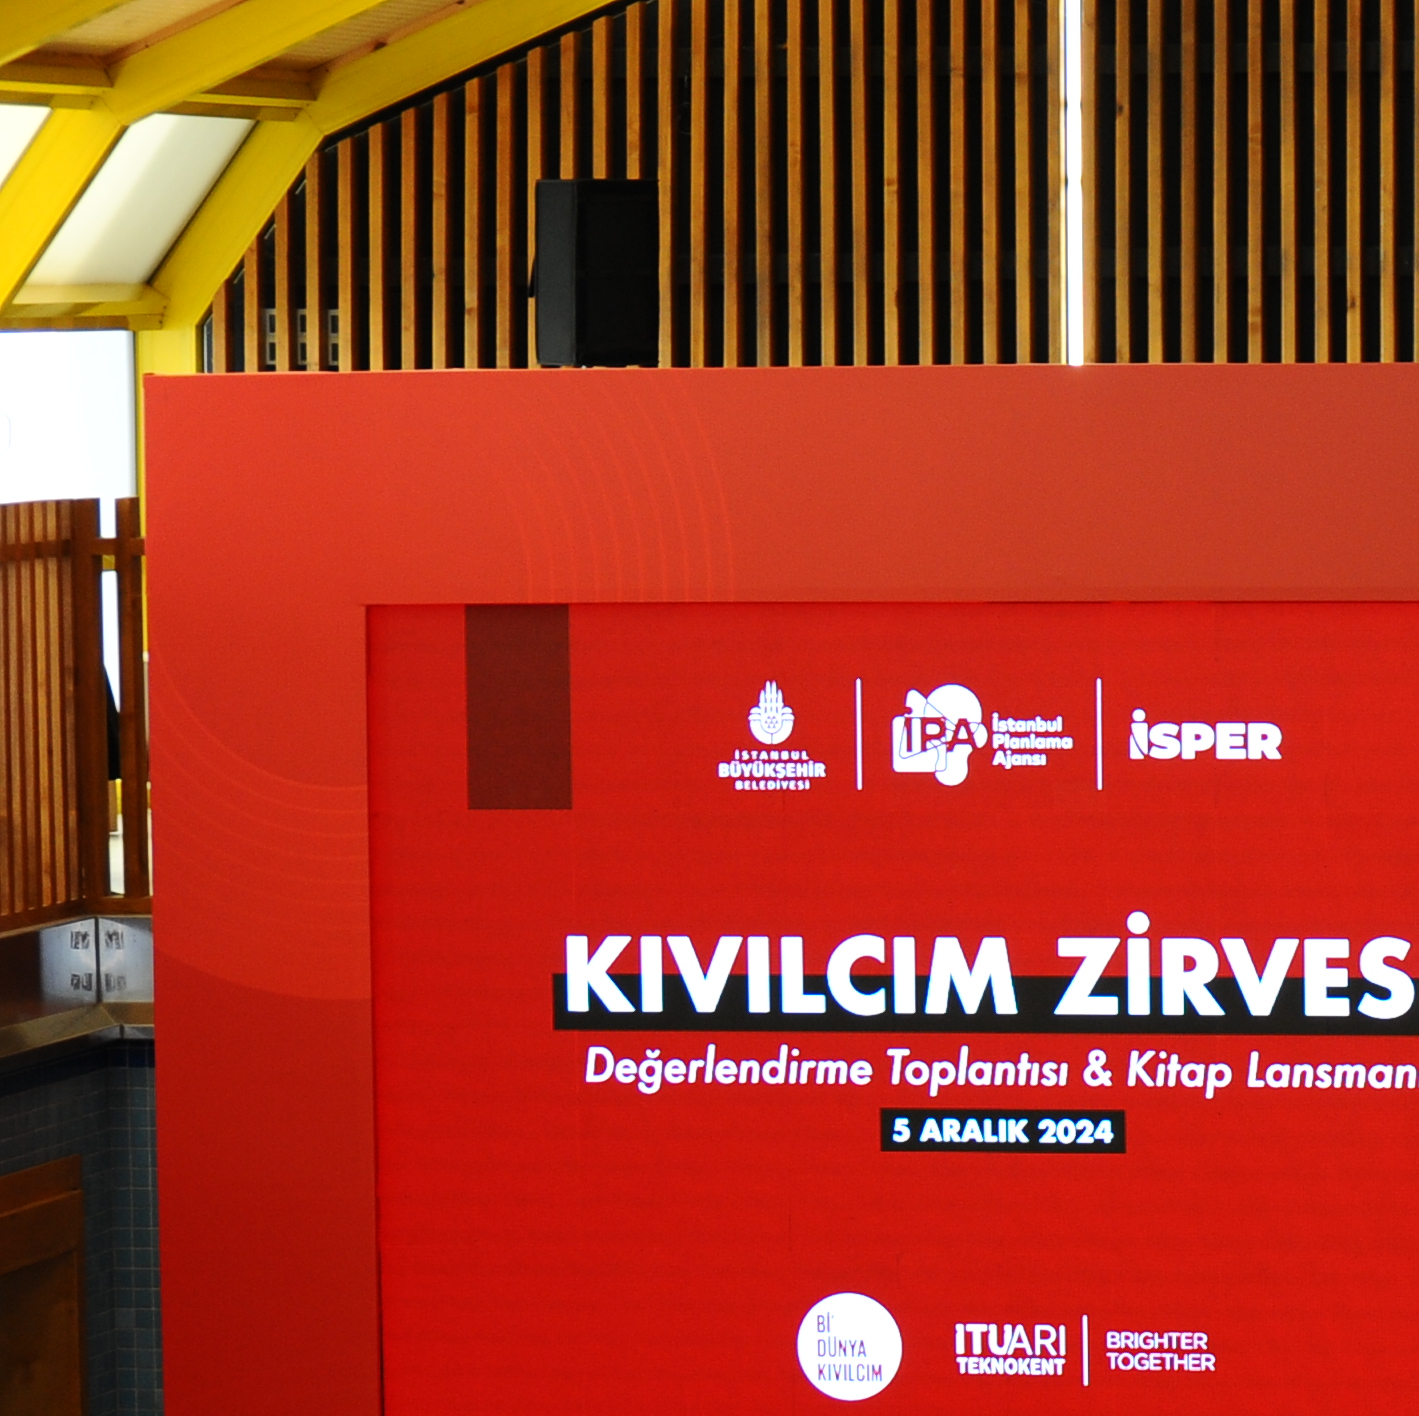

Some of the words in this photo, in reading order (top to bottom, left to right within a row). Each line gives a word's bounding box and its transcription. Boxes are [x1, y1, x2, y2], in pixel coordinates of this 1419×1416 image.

[992, 712, 1062, 733] İstanbul
[993, 733, 1073, 749] Planlama
[1130, 709, 1282, 759] İSPER
[992, 750, 1046, 769] Ajansı
[719, 760, 825, 779] BÜYÜKŞEHİR
[566, 934, 1018, 1016] KIVILCIM
[586, 1044, 873, 1094] Değerlendirme
[887, 1045, 1068, 1097] Toplantısı
[1083, 1049, 1112, 1086] &
[1127, 1050, 1232, 1099] Kitap
[893, 1118, 910, 1142] 5
[920, 1118, 1029, 1143] ARALIK
[1038, 1119, 1114, 1144] 2024
[817, 1336, 867, 1357] DÜNYA
[1107, 1331, 1207, 1350] BRIGHTER
[957, 1357, 1065, 1375] TEKNOKENT
[1106, 1352, 1215, 1371] TOGETHER
[818, 1363, 882, 1382] KIVILCIM
